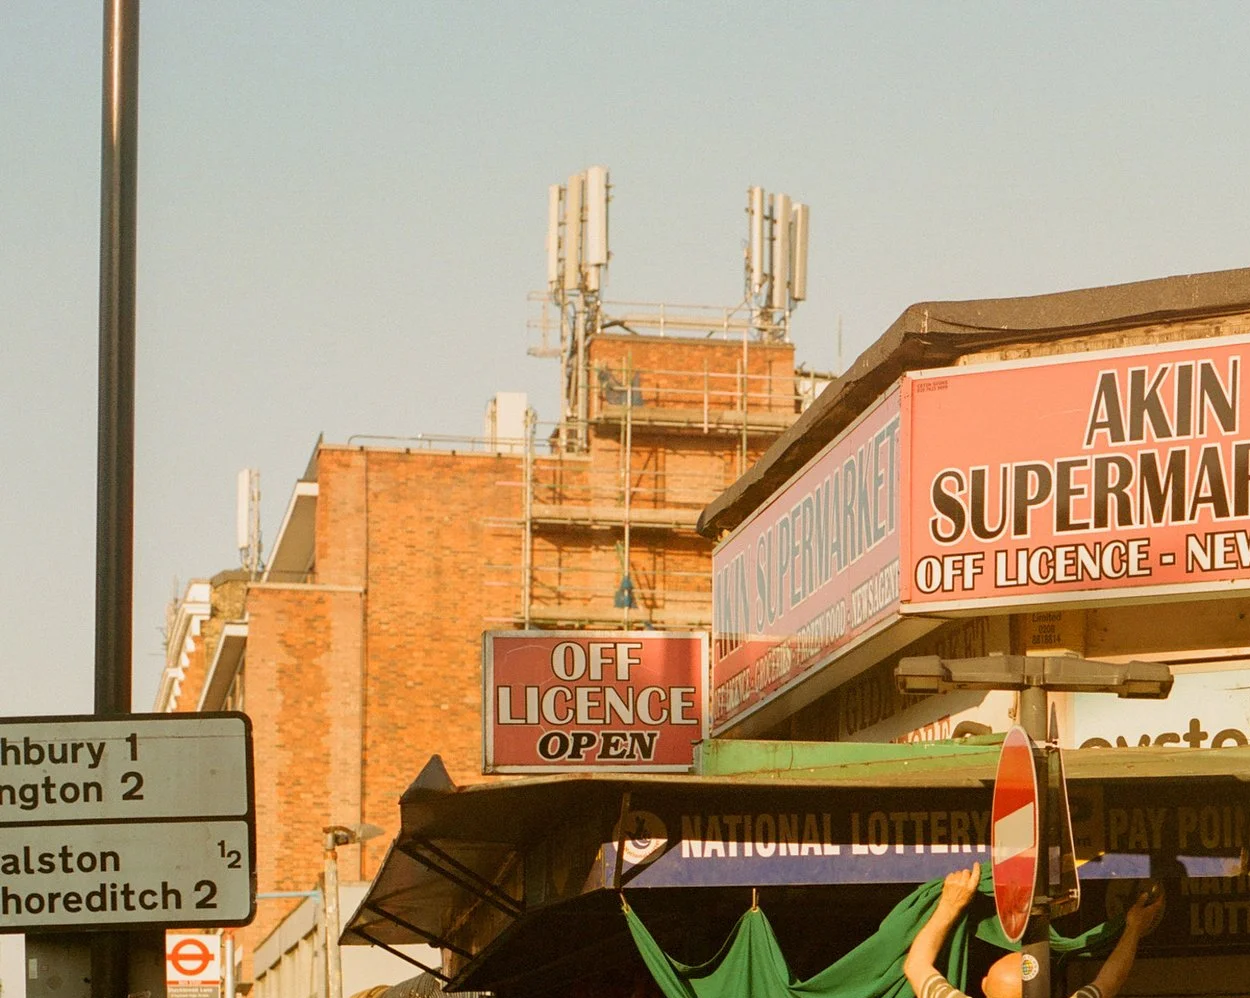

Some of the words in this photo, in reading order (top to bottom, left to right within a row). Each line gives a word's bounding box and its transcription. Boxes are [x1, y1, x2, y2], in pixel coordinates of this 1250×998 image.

[1082, 355, 1240, 449] AKIN
[756, 412, 899, 634] SUPERMARKET
[915, 551, 983, 594] OFF
[995, 538, 1151, 588] LICENCE
[551, 641, 642, 681] OFF
[497, 686, 699, 726] LICENCE
[1, 736, 106, 769] hbury
[126, 733, 138, 761] 1
[538, 731, 657, 760] OPEN
[0, 776, 103, 810] ngton
[121, 772, 144, 801] 2
[681, 811, 840, 858] NATIONAL
[851, 810, 991, 855] LOTTERY
[1109, 807, 1169, 849] PAY
[1, 846, 120, 875] alston
[2, 882, 182, 914] horeditch
[194, 880, 217, 909] 2
